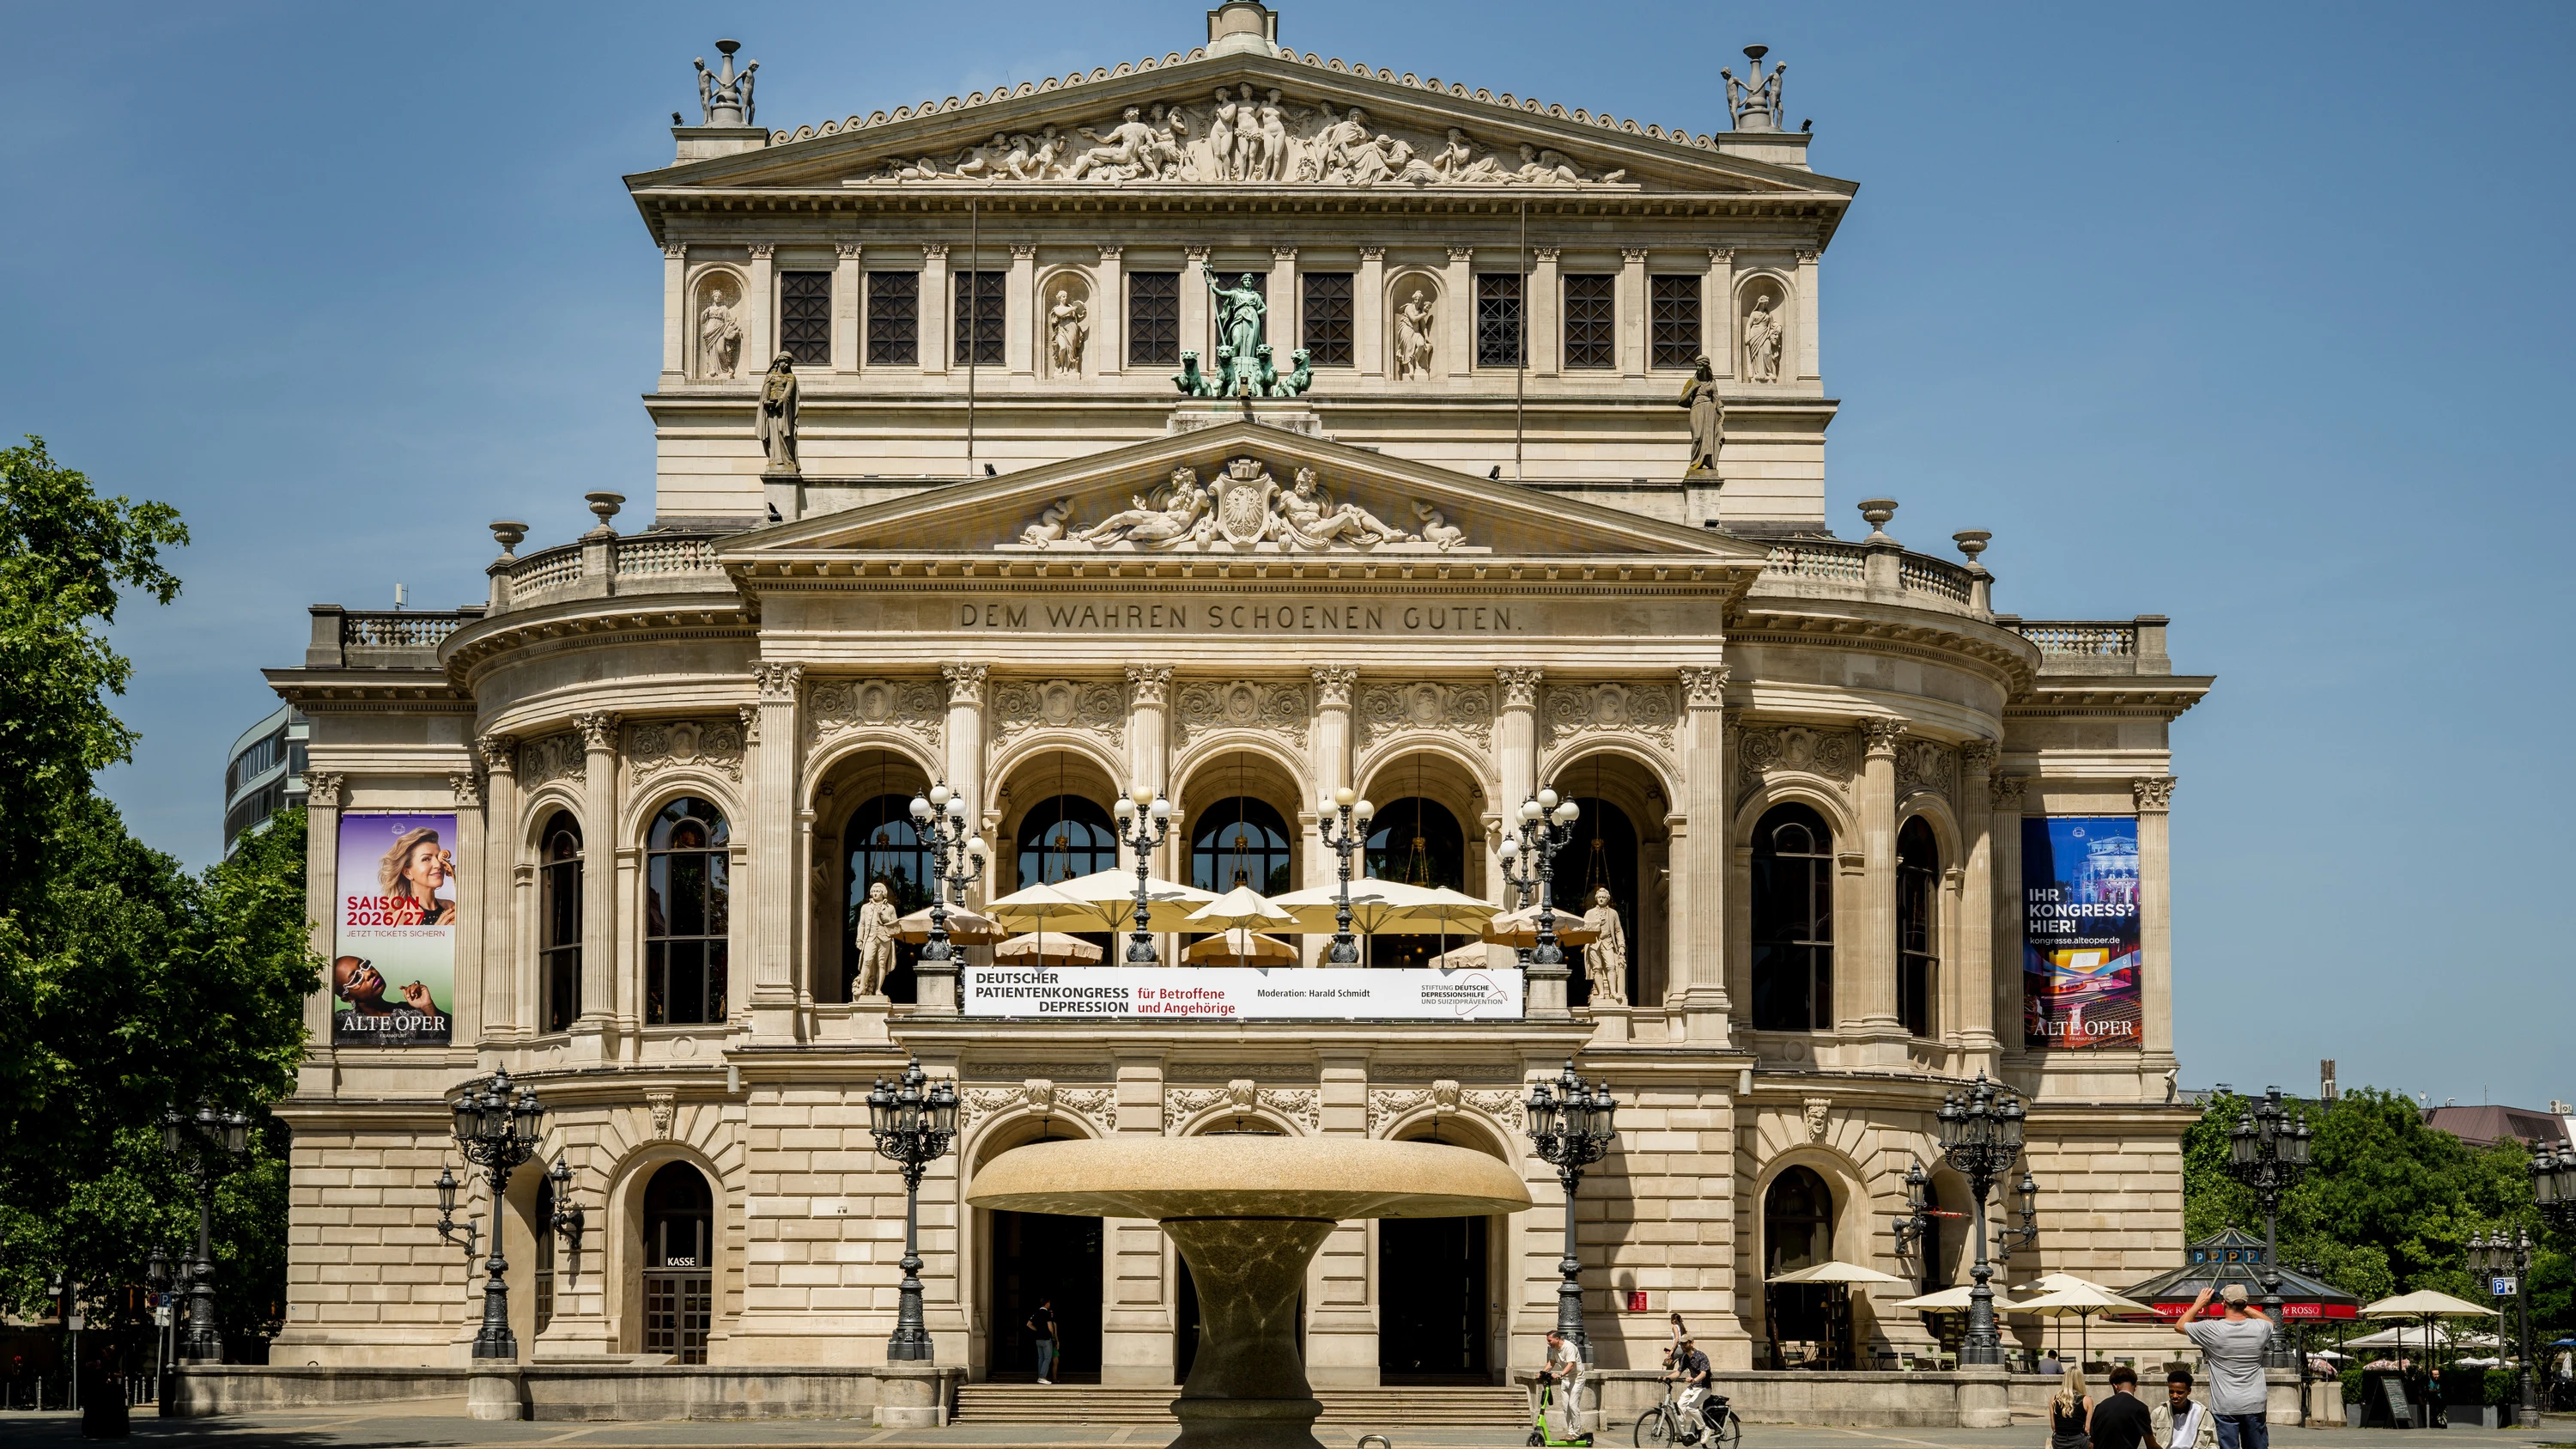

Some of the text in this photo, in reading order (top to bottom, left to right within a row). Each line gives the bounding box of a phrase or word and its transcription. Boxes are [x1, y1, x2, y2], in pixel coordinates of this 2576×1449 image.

[961, 604, 1522, 630] DEM WAHREN SCHOENEN GUTEN.
[2029, 888, 2059, 902] IHR
[347, 896, 419, 910] SAISON
[2029, 904, 2135, 916] KONGRESS?
[347, 910, 425, 928] 2026/27
[2029, 920, 2076, 933] HIER!
[2030, 936, 2120, 945] kongresse.alteoper.de
[975, 973, 1059, 983] DEUTSCHER
[975, 987, 1129, 998] PATIENTENKONGRESS
[1138, 988, 1225, 999] für Betroffene
[1039, 1002, 1129, 1013] DEPRESSION
[1138, 1002, 1236, 1016] und Angehörige
[343, 1016, 446, 1031] ALTE OPER
[2033, 1021, 2133, 1036] ALTE OPER
[667, 1257, 695, 1266] KASSE
[2495, 1282, 2503, 1294] P
[161, 1294, 168, 1306] P
[2291, 1306, 2319, 1314] ROSSO
